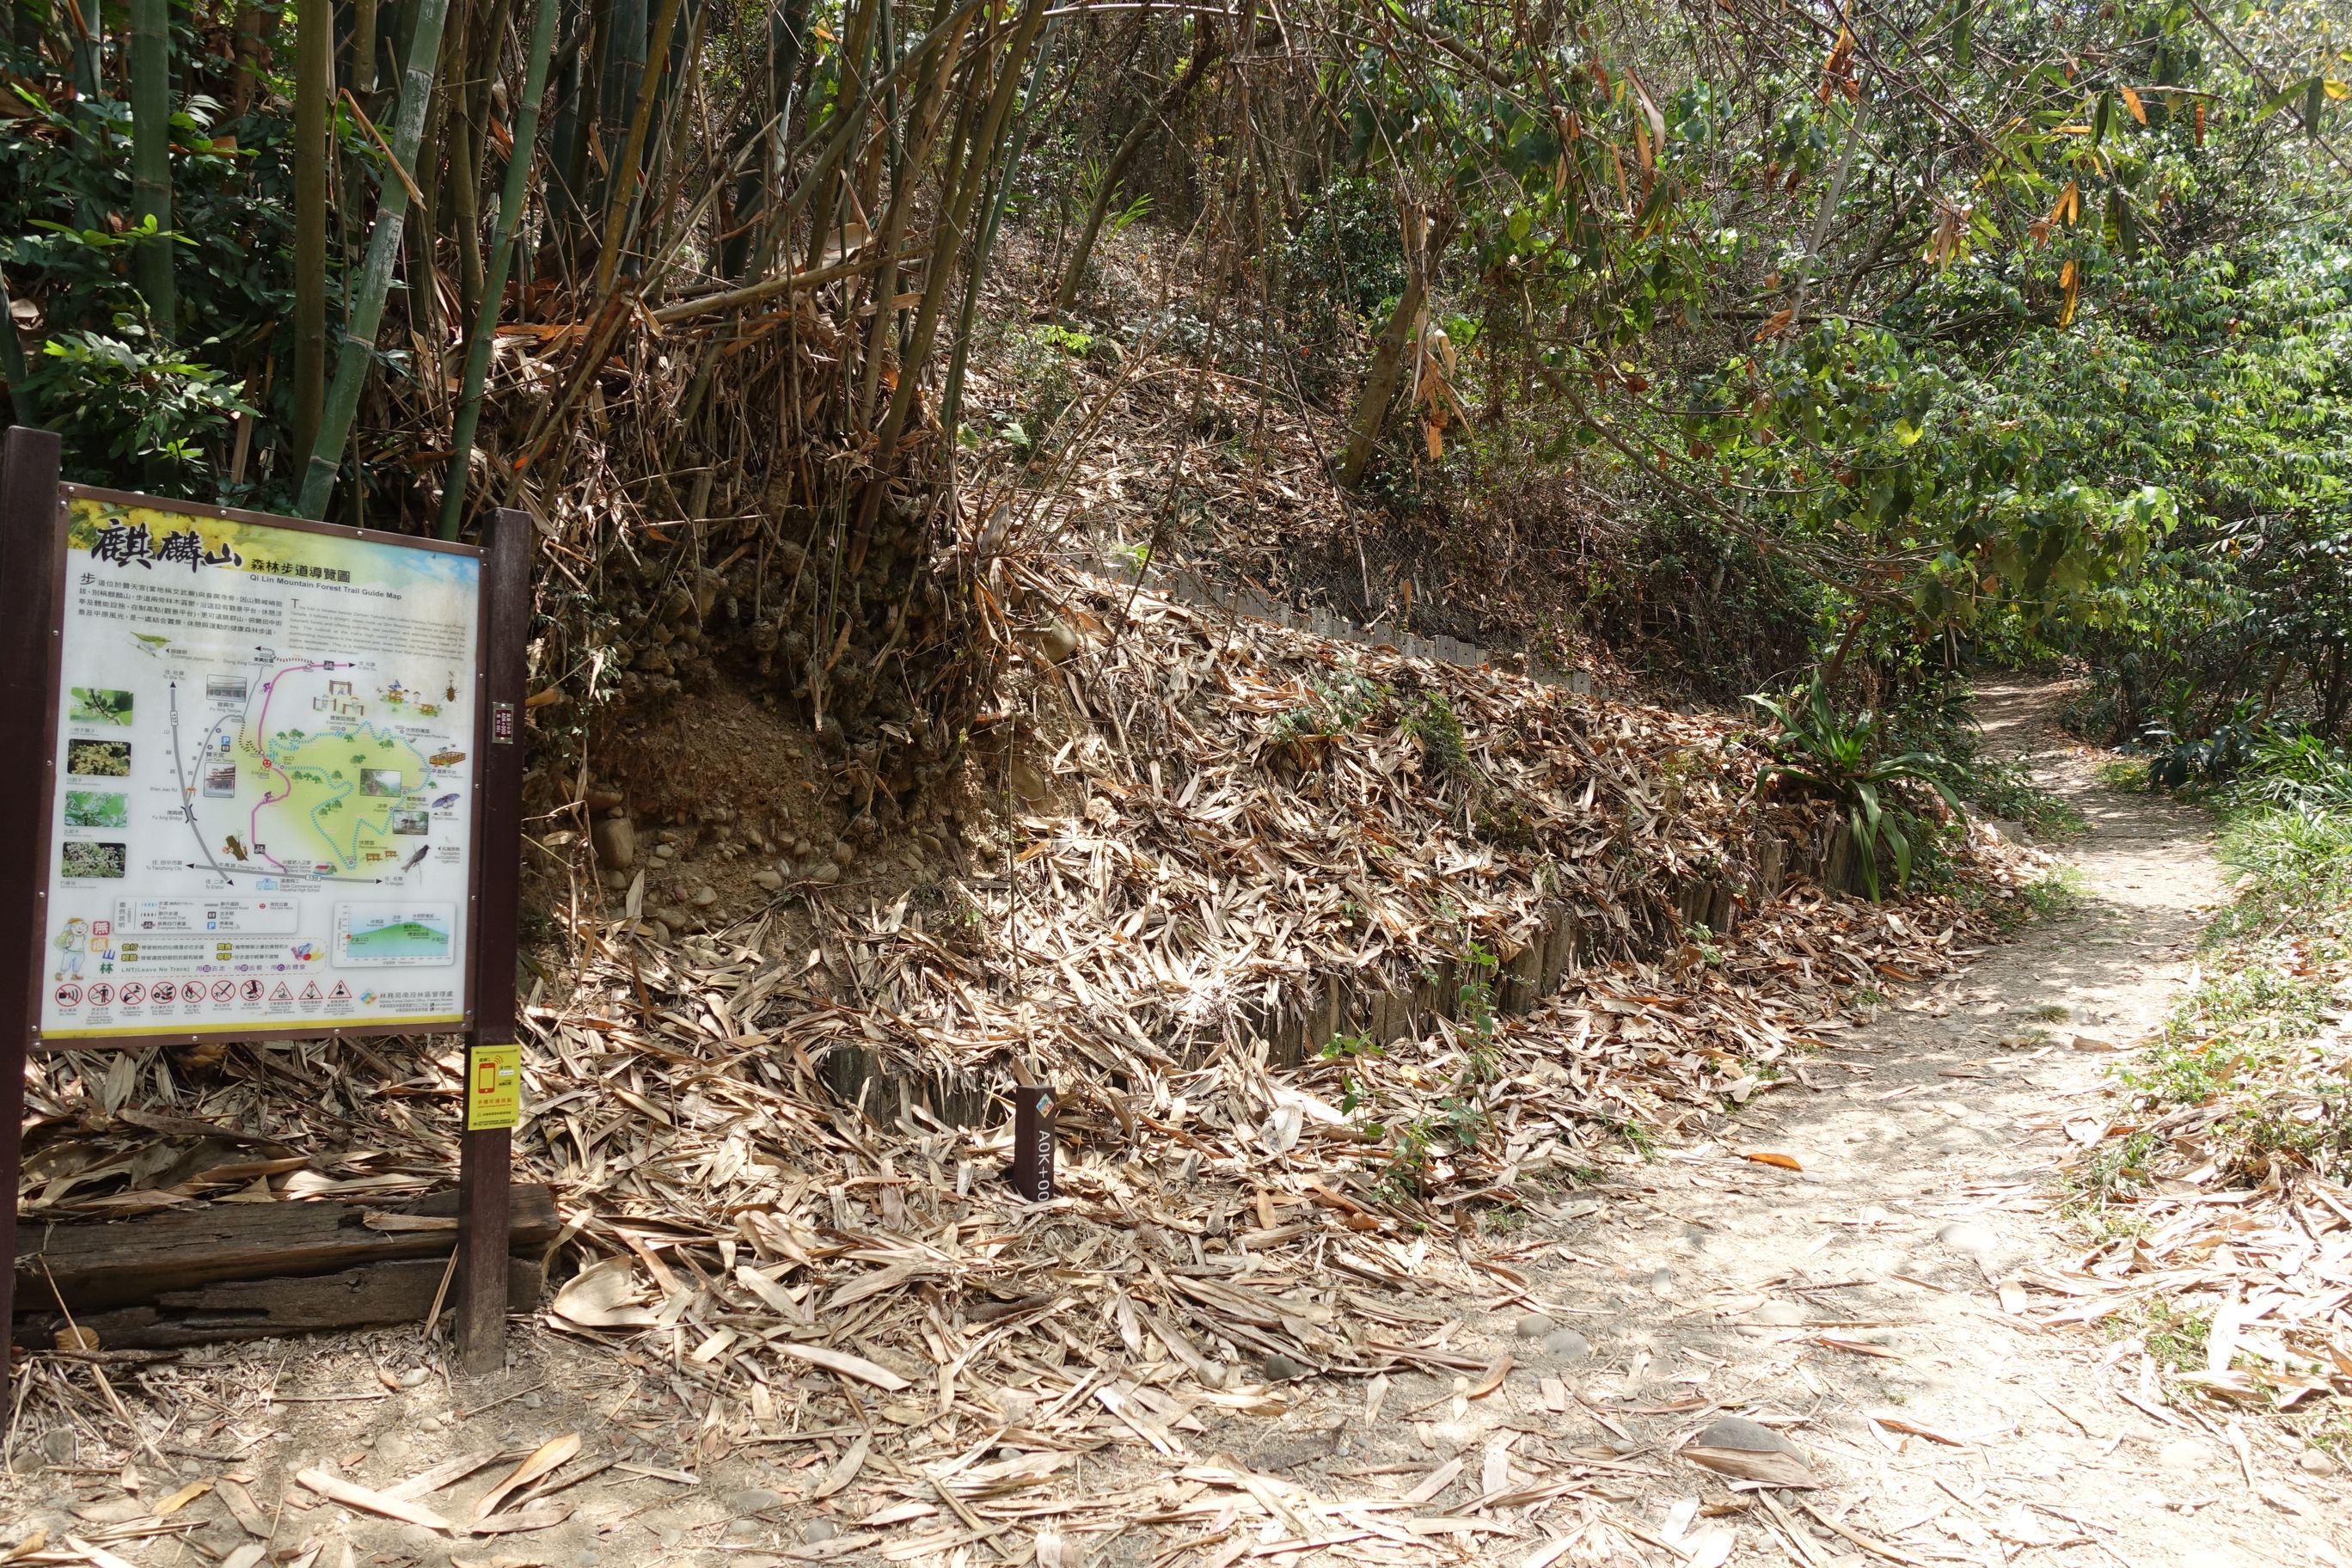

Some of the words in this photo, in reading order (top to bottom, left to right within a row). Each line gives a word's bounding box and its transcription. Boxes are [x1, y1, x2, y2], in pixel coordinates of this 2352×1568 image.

[251, 559, 351, 583] 森林步道導覽圖
[249, 573, 260, 582] Qi
[261, 575, 275, 584] Lin
[277, 577, 315, 589] Mountain
[315, 582, 341, 592] Forest
[344, 585, 360, 595] Trail
[361, 588, 384, 597] Guide
[386, 591, 402, 600] Map
